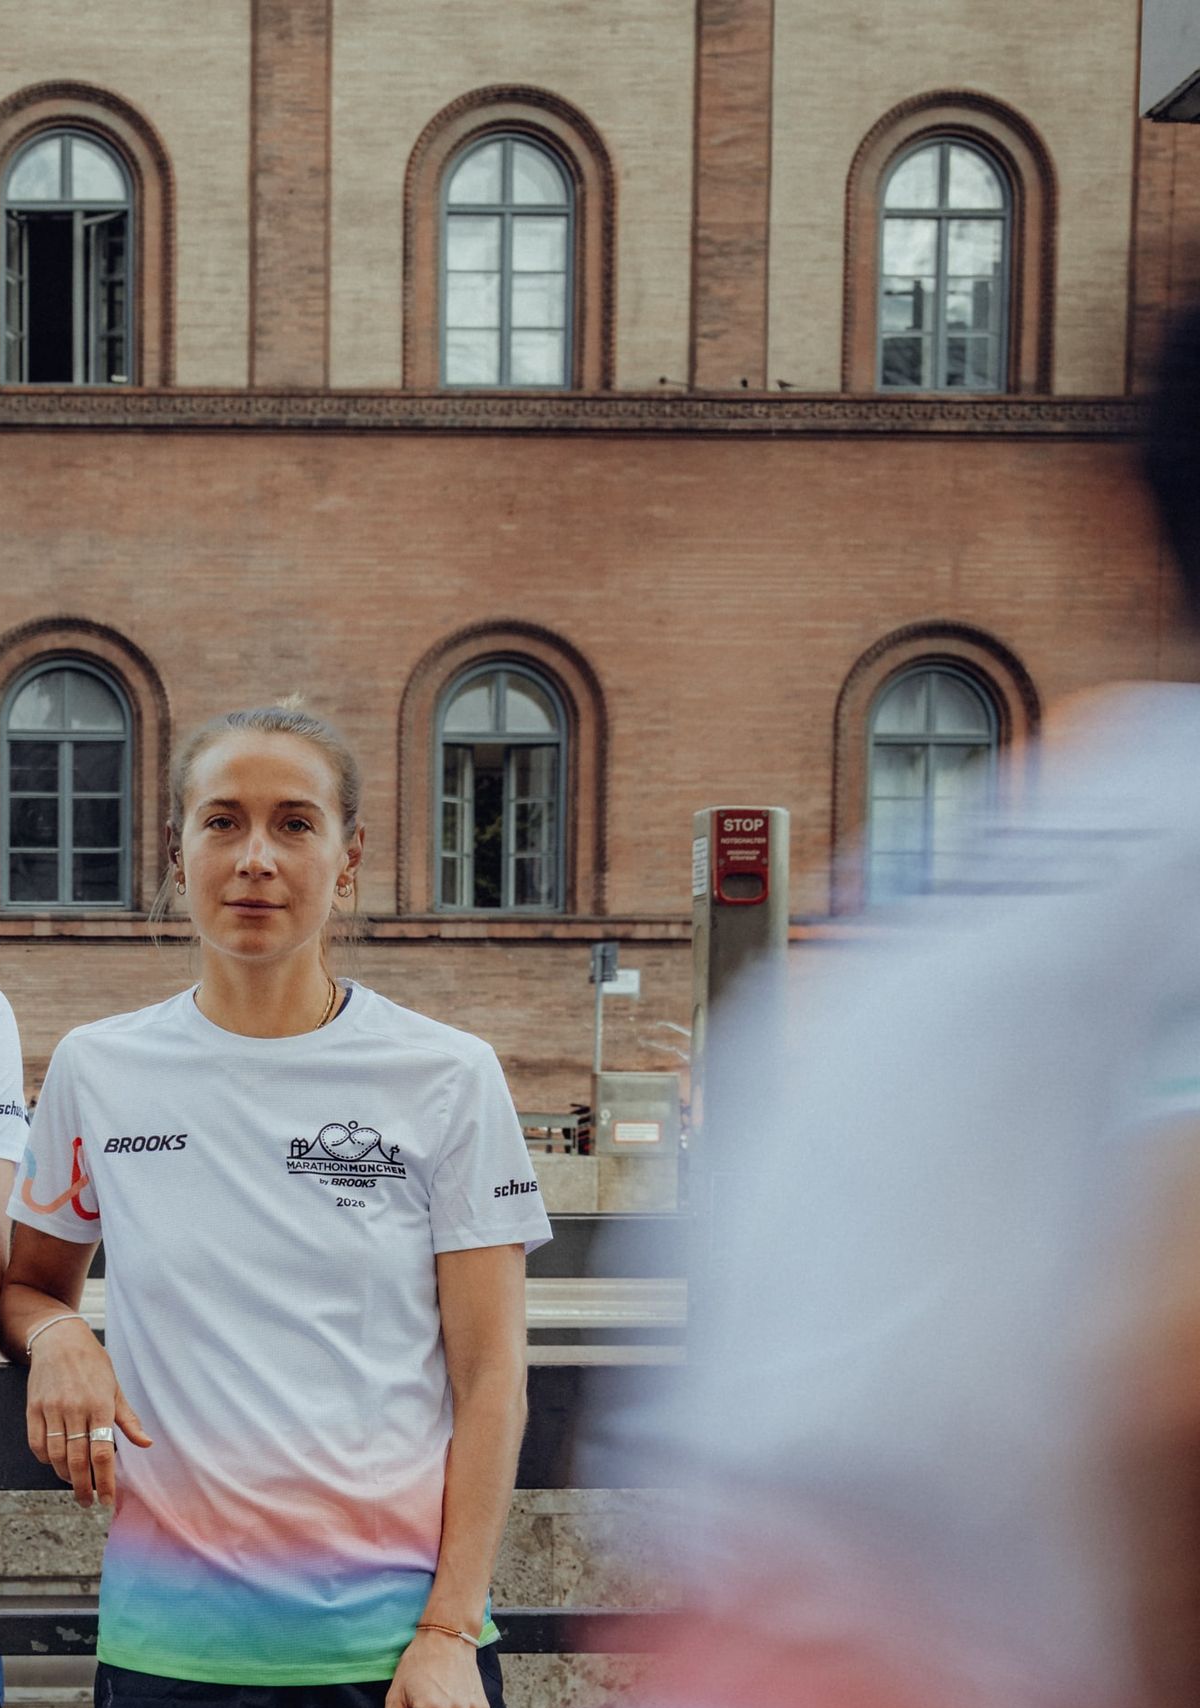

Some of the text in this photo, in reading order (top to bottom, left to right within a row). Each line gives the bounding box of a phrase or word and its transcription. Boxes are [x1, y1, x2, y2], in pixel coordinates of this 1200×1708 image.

[723, 818, 764, 831] STOP
[103, 1134, 188, 1153] BROOKS
[319, 1178, 377, 1188] by BROOKS
[493, 1179, 538, 1198] schus
[336, 1197, 366, 1208] 2026
